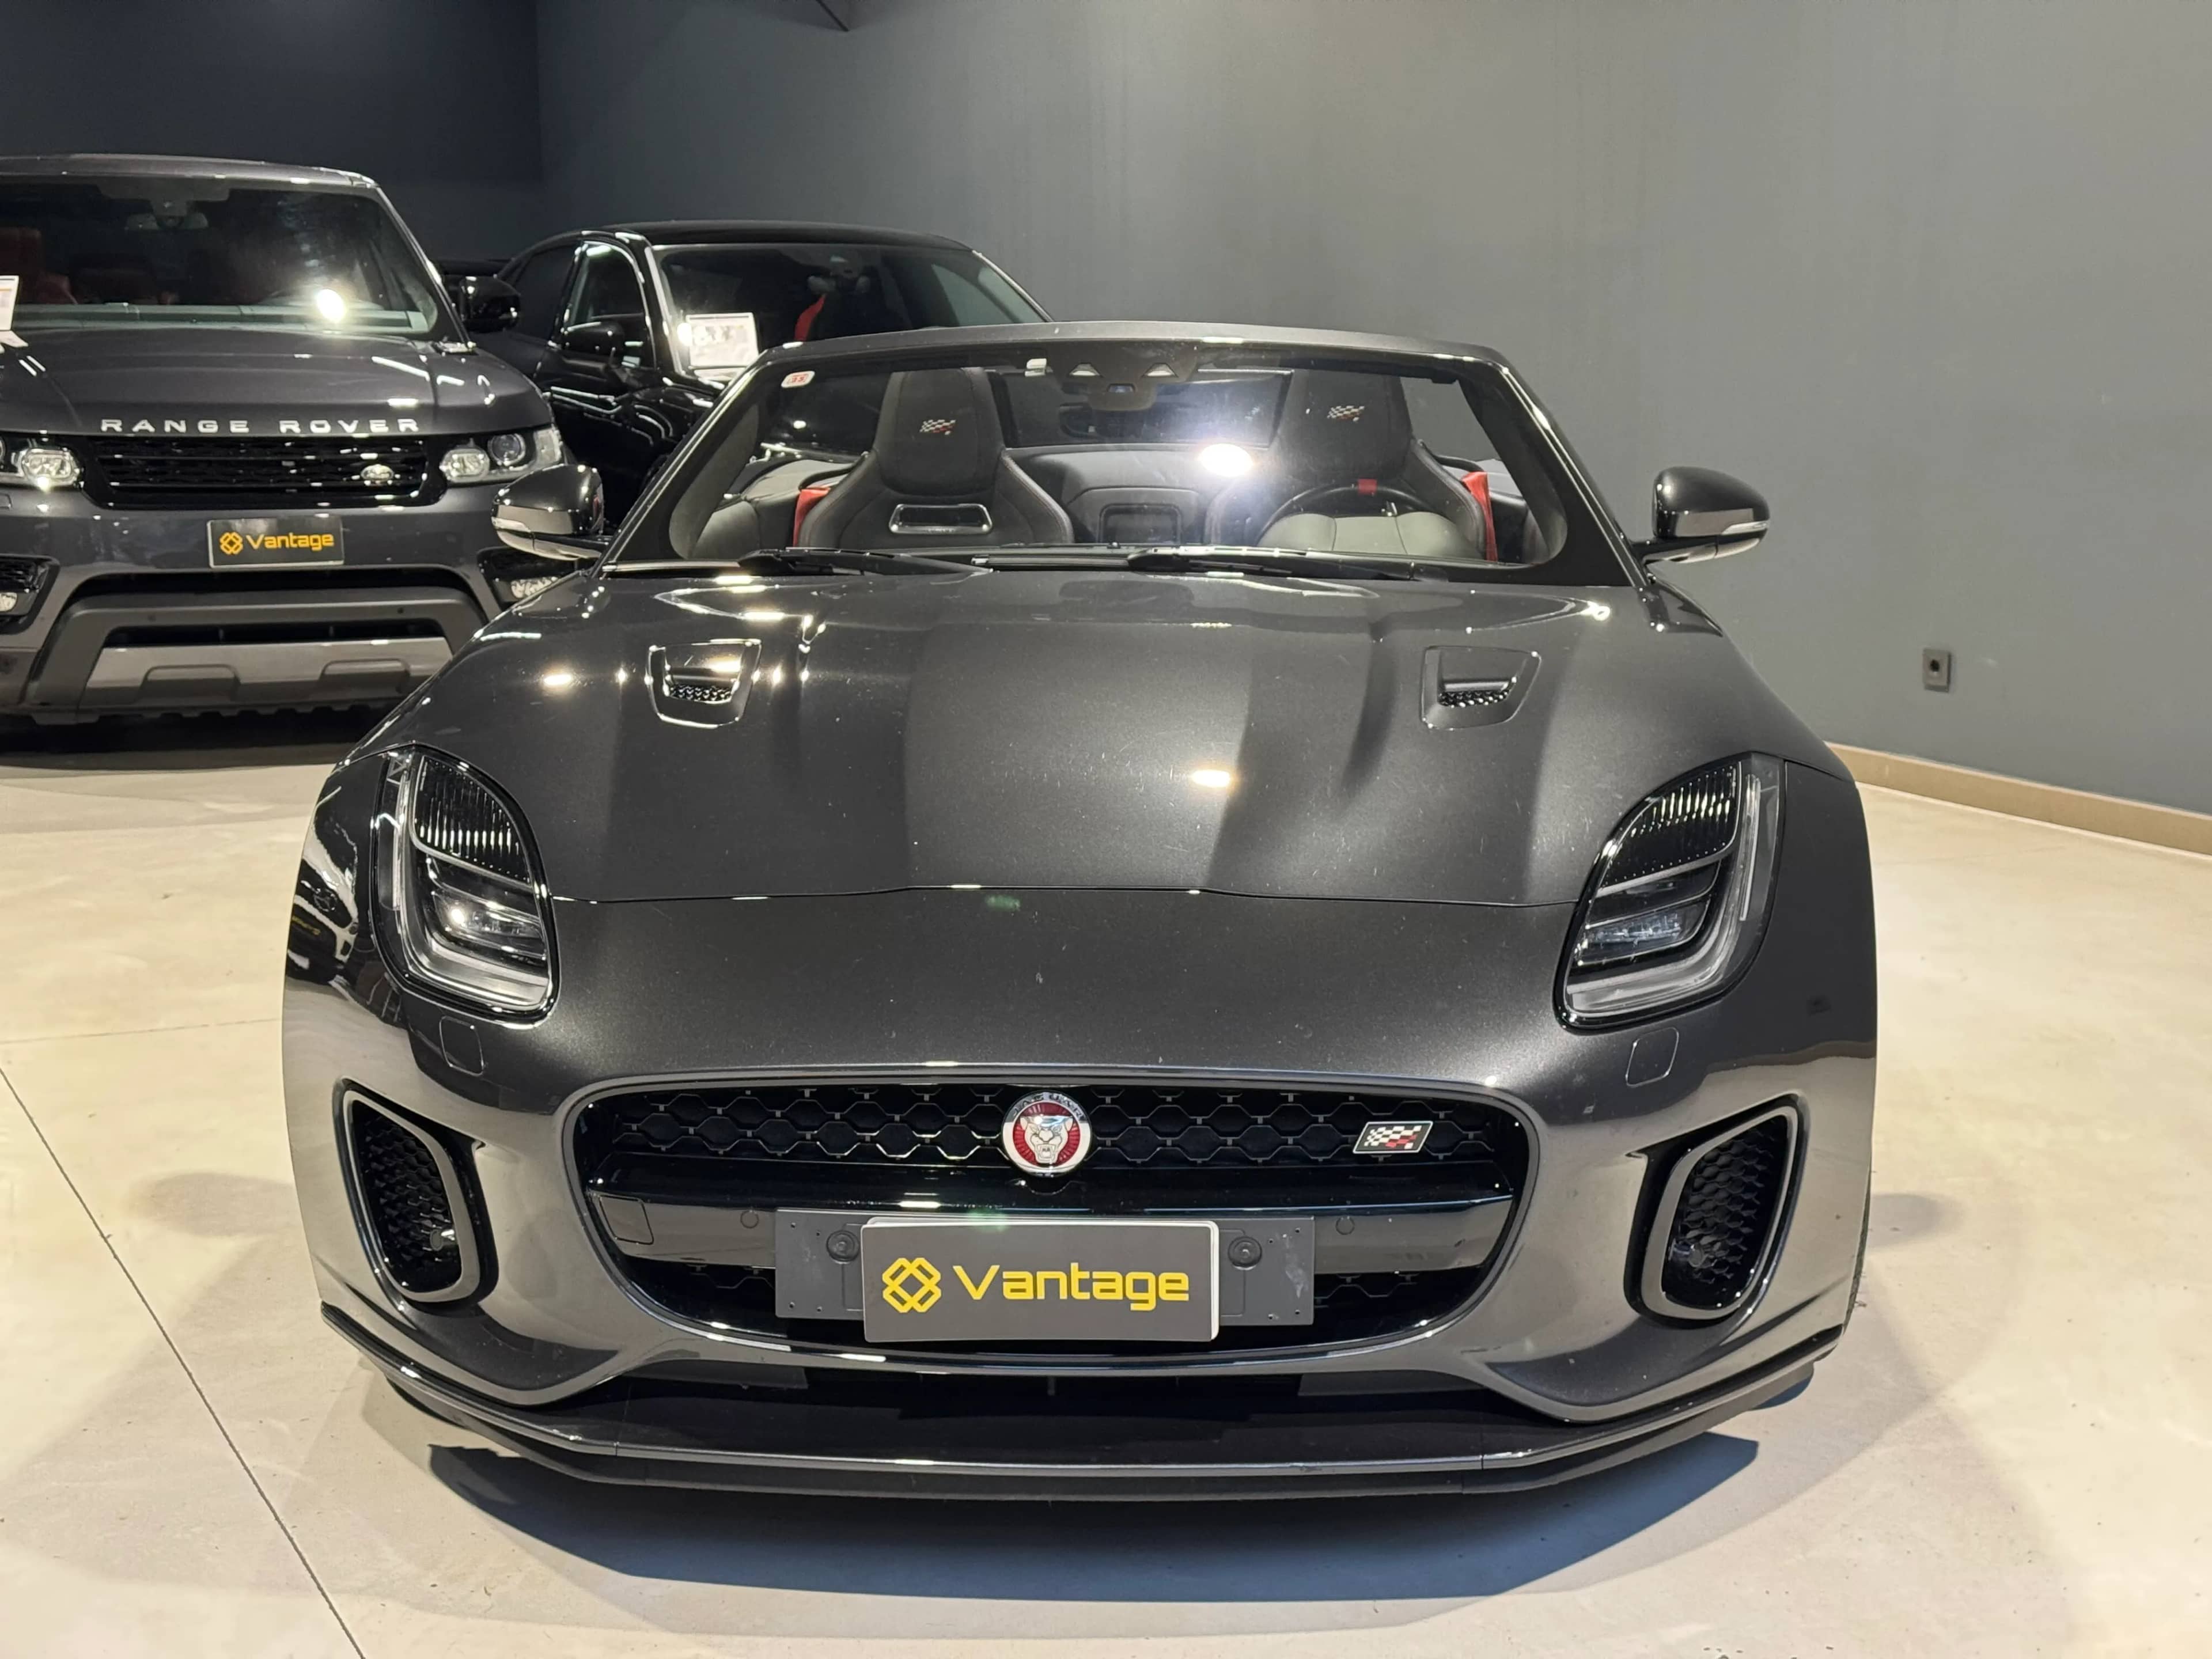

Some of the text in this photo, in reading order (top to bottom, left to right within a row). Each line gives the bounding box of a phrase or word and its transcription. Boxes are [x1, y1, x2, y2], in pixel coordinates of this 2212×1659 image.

[101, 418, 419, 434] RANGE ROVER
[246, 532, 335, 551] Vantage
[1013, 1093, 1085, 1120] JAGUAR
[953, 1263, 1190, 1311] Vantage
